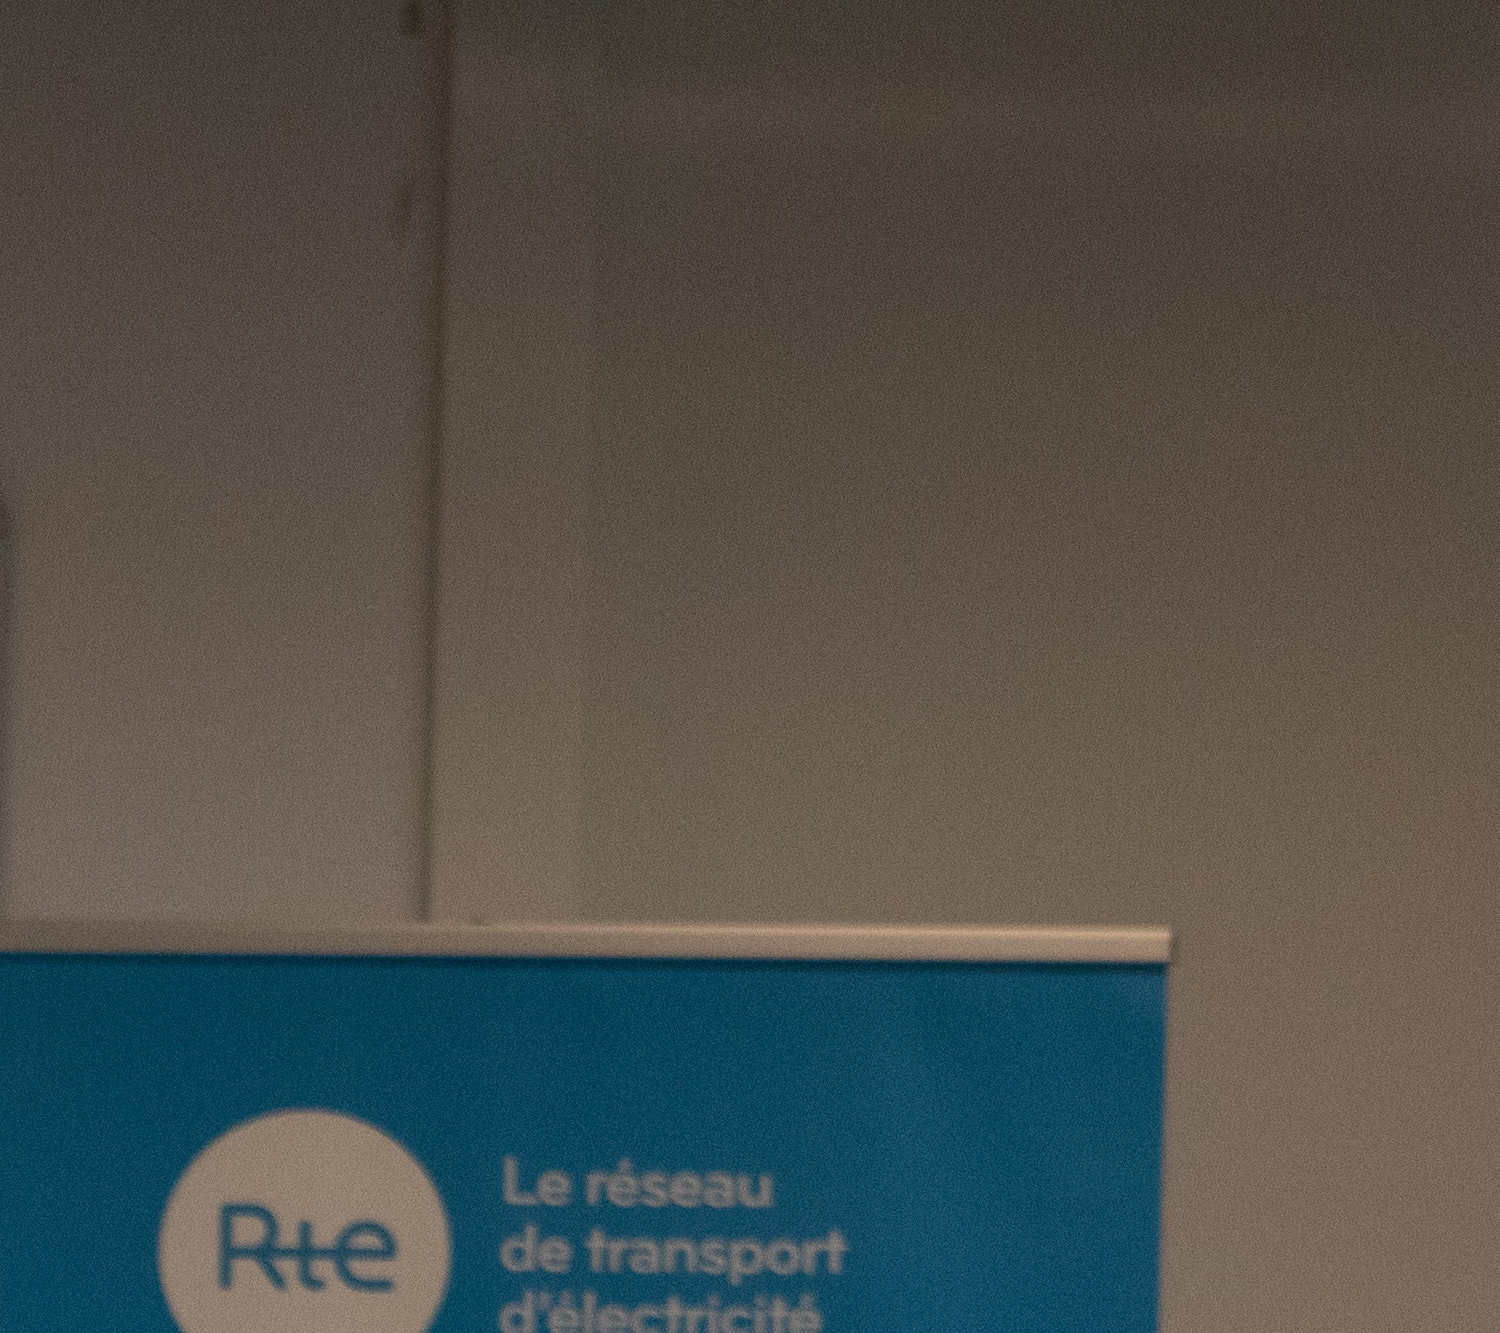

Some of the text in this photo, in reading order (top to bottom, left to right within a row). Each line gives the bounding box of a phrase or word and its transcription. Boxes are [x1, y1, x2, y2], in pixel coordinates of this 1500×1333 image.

[502, 1155, 775, 1208] Le réseau
[216, 1202, 400, 1293] Rte
[500, 1222, 846, 1287] de transport
